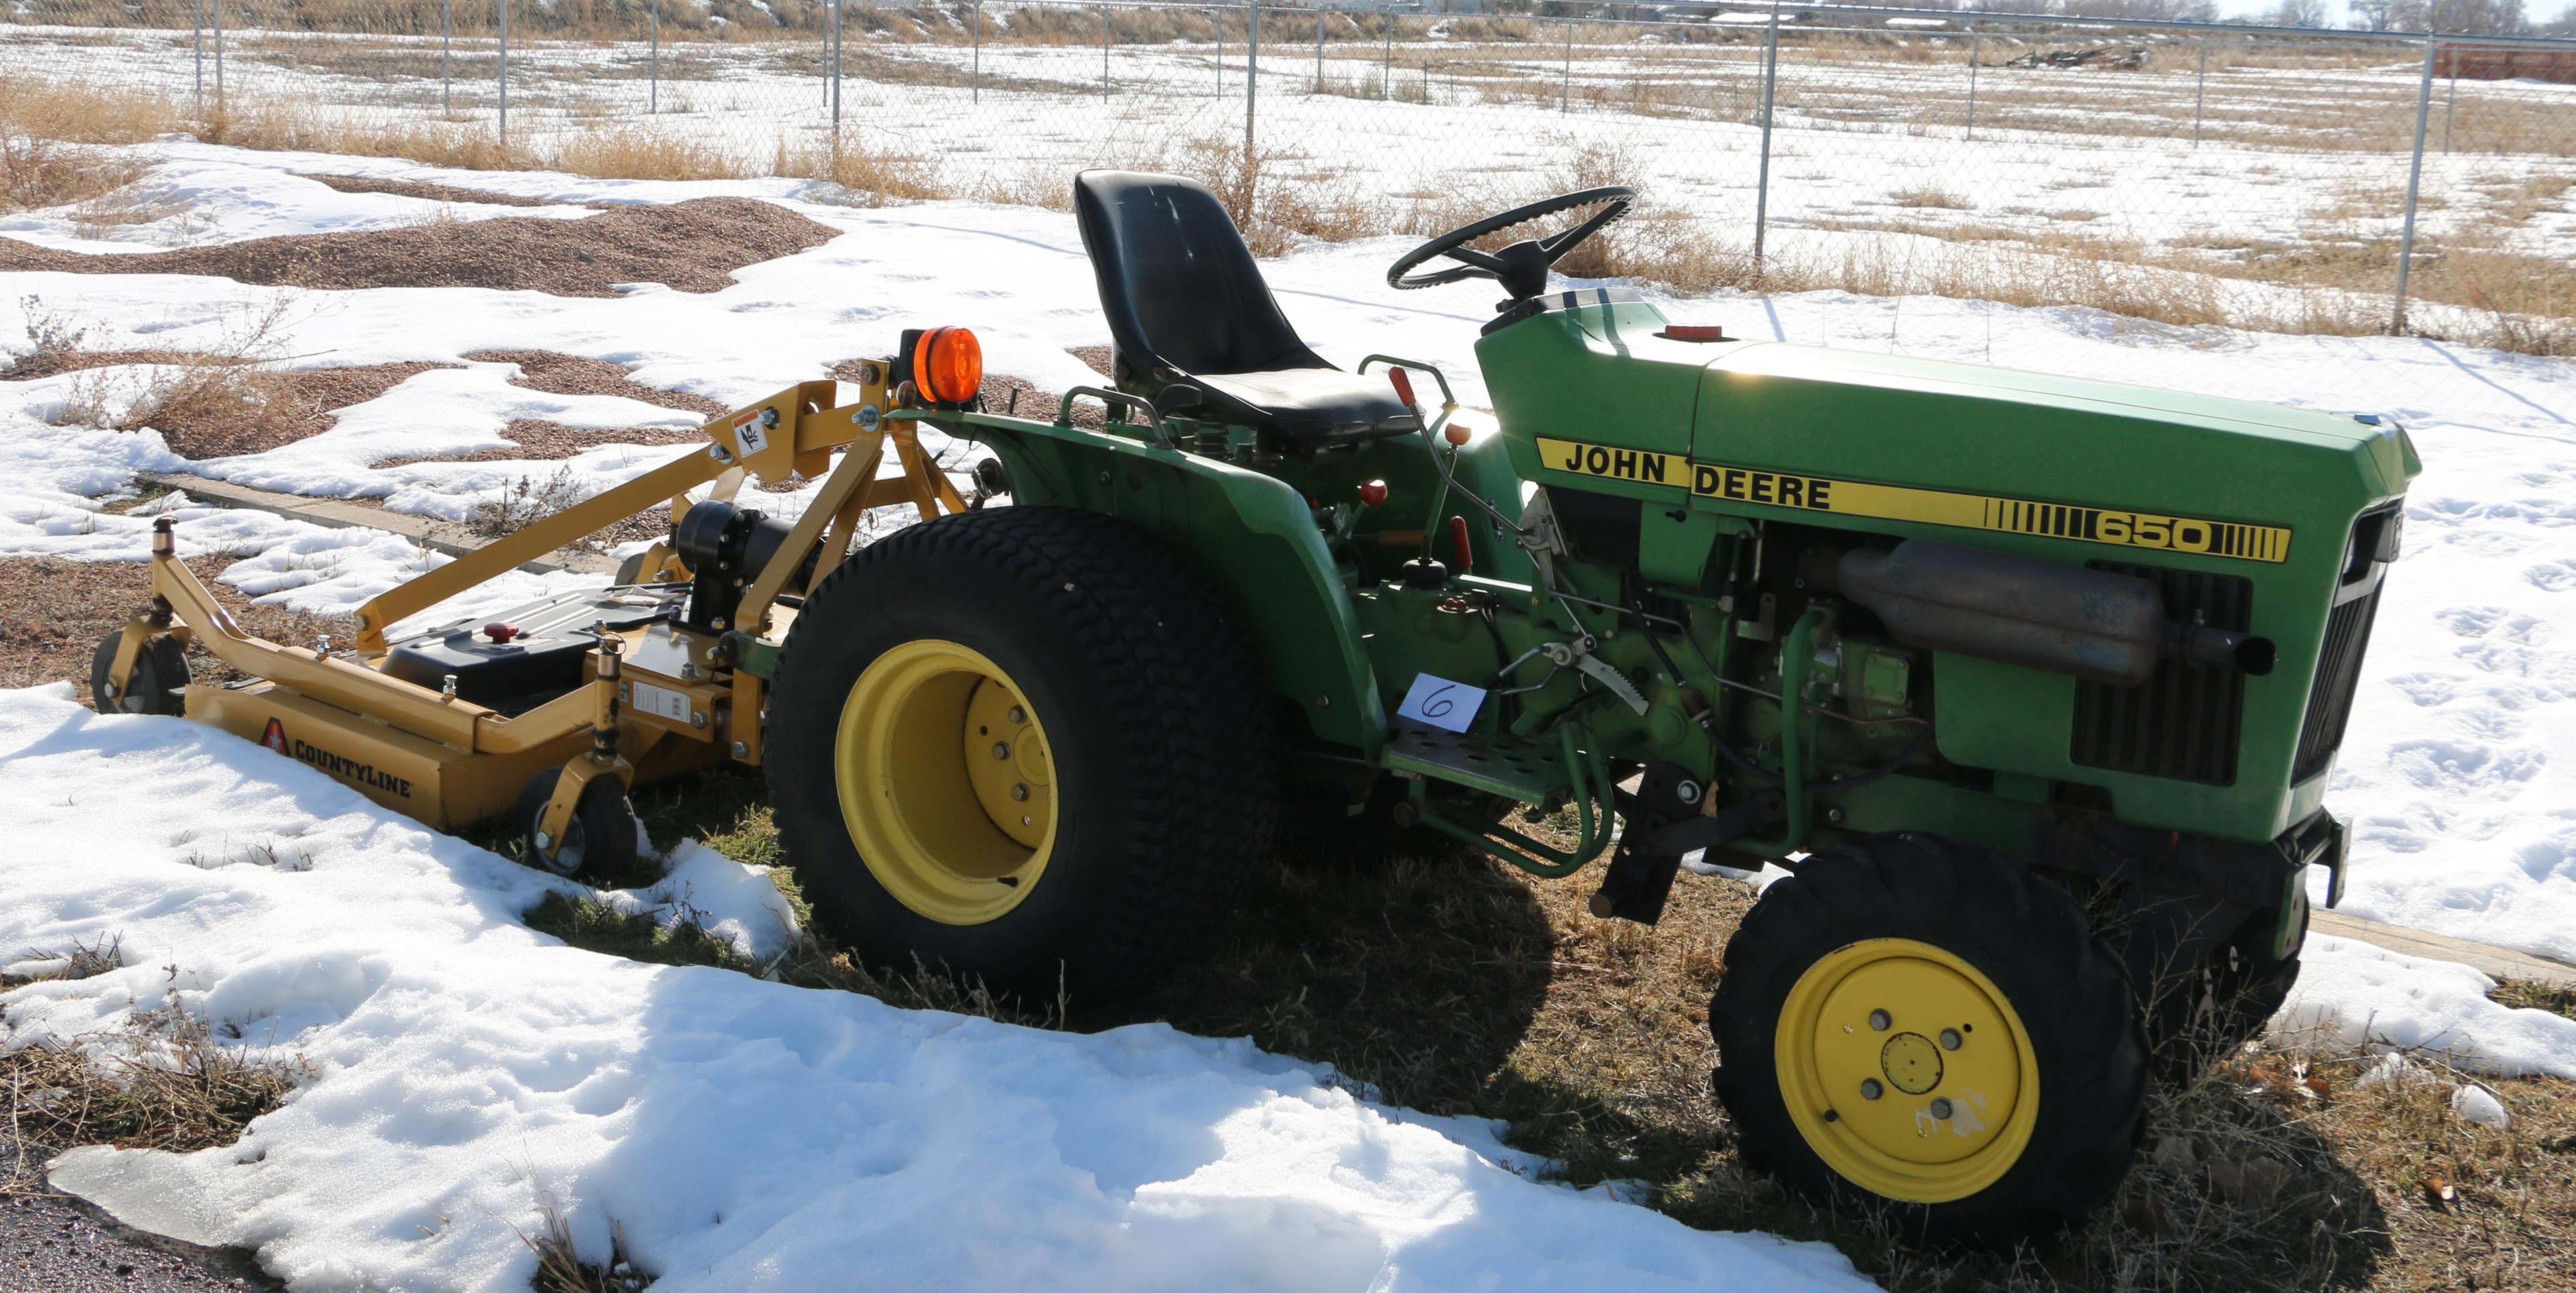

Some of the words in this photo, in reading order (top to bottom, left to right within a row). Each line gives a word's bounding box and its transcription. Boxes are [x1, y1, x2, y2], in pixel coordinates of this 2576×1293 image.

[1565, 444, 1666, 483] JOHN
[1695, 466, 1831, 510] DEERE
[2095, 511, 2212, 552] 650
[1421, 684, 1456, 718] 6
[294, 739, 411, 798] COUNTYLINE
